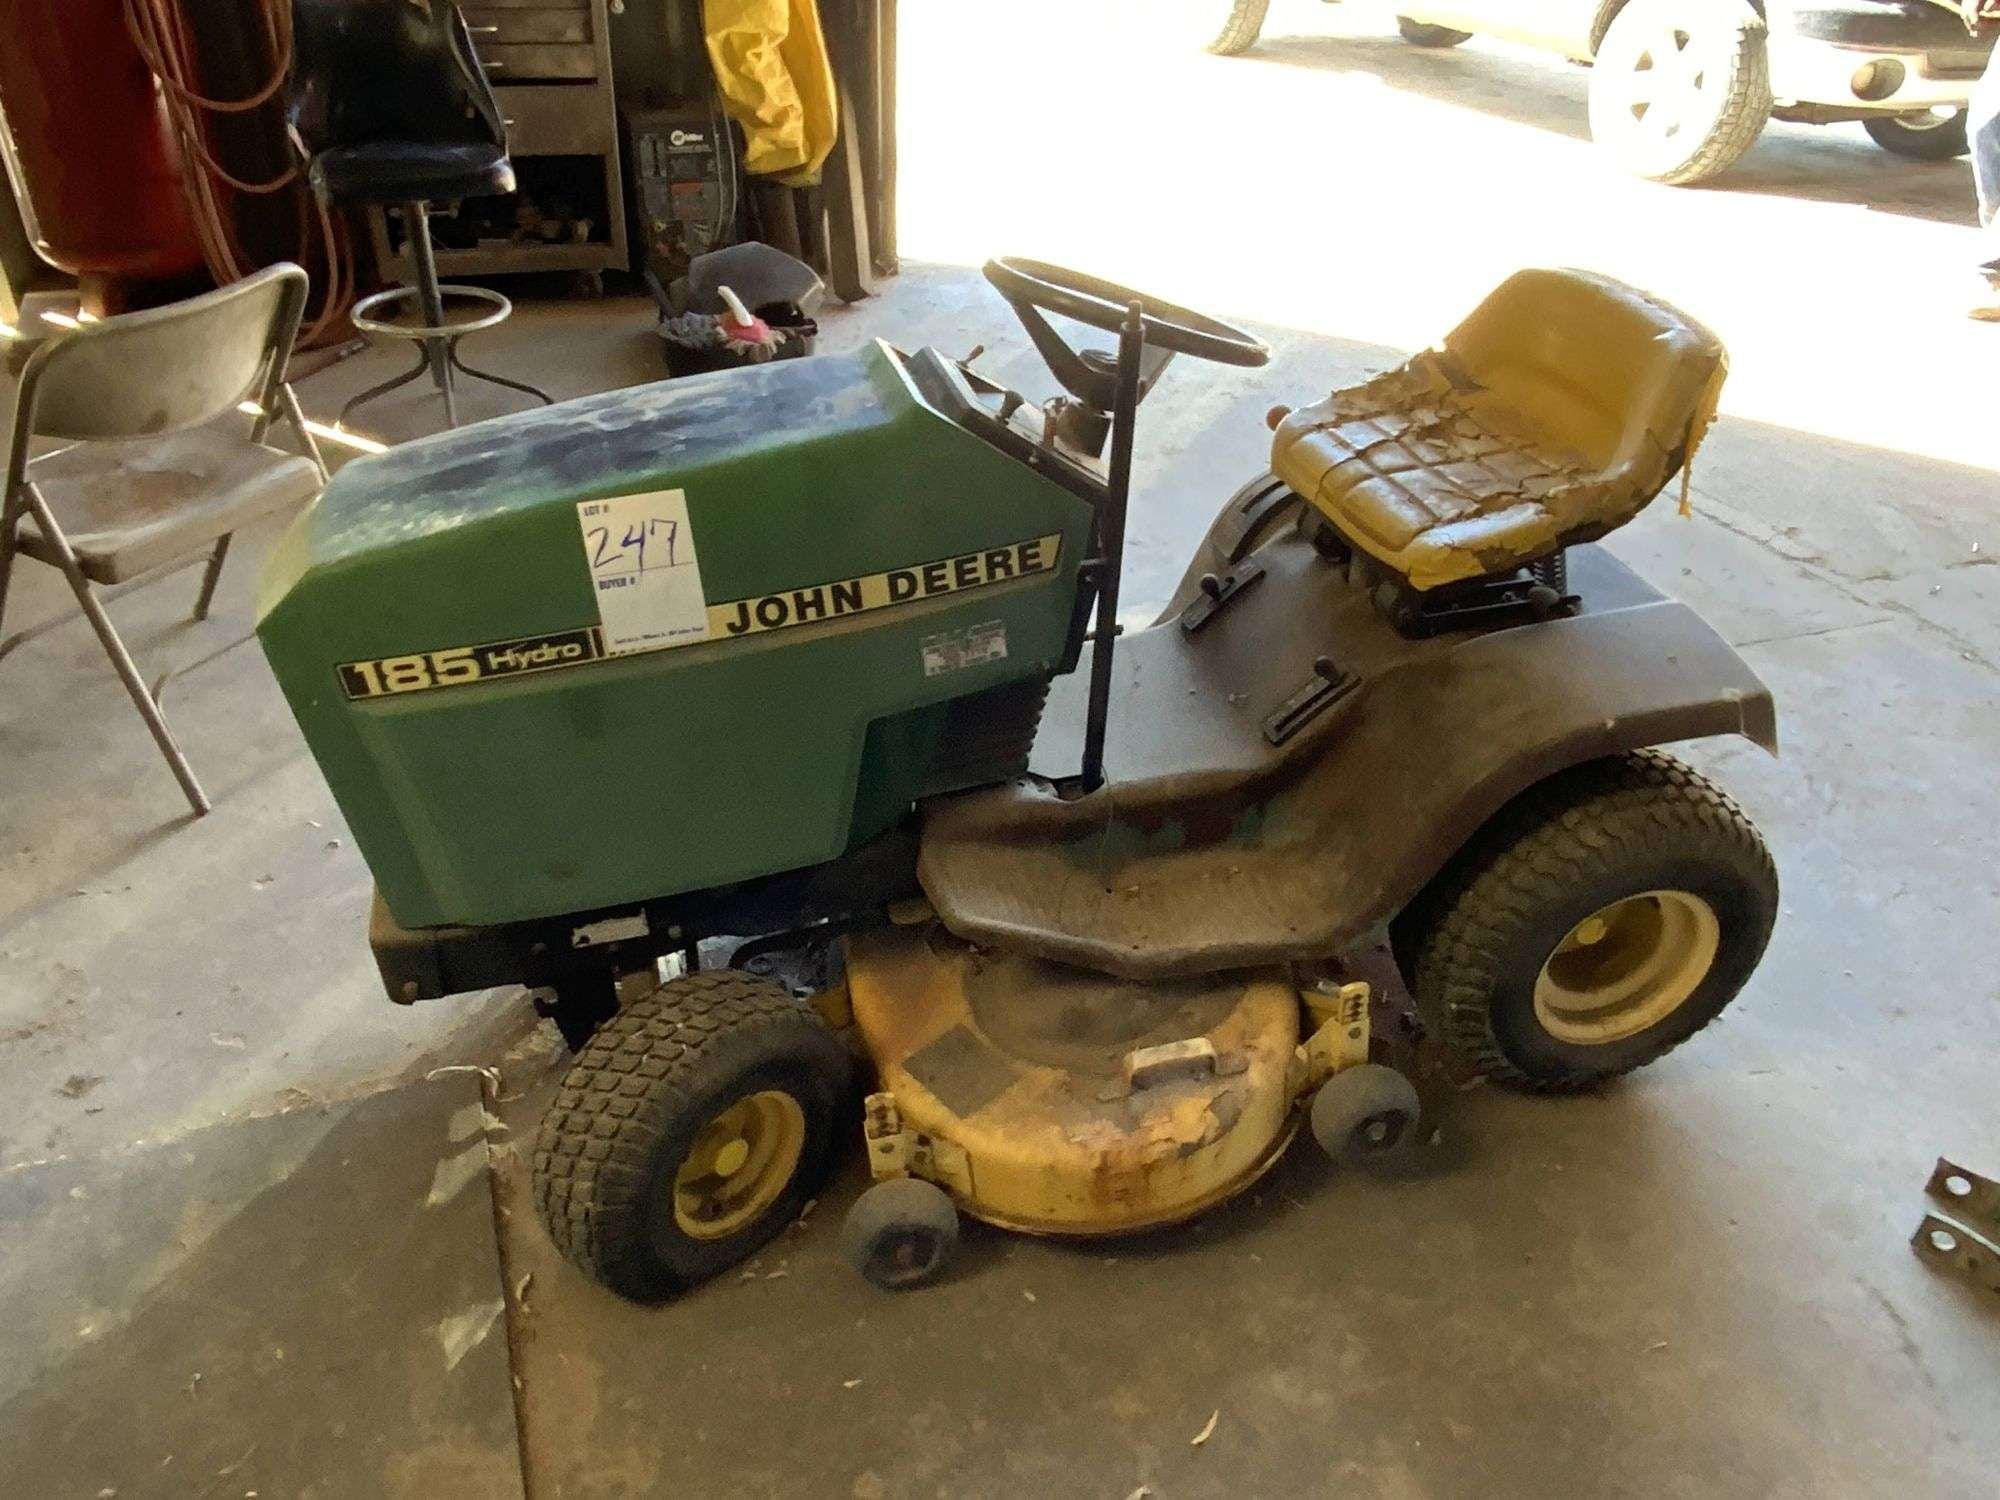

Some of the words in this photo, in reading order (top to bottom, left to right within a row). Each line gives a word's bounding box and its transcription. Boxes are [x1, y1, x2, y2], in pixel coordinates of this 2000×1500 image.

[583, 505, 600, 517] LOT
[587, 518, 678, 574] 247
[726, 580, 865, 635] JOHN
[886, 540, 1042, 601] DEERE
[352, 648, 482, 697] 185
[487, 639, 582, 671] Hydro
